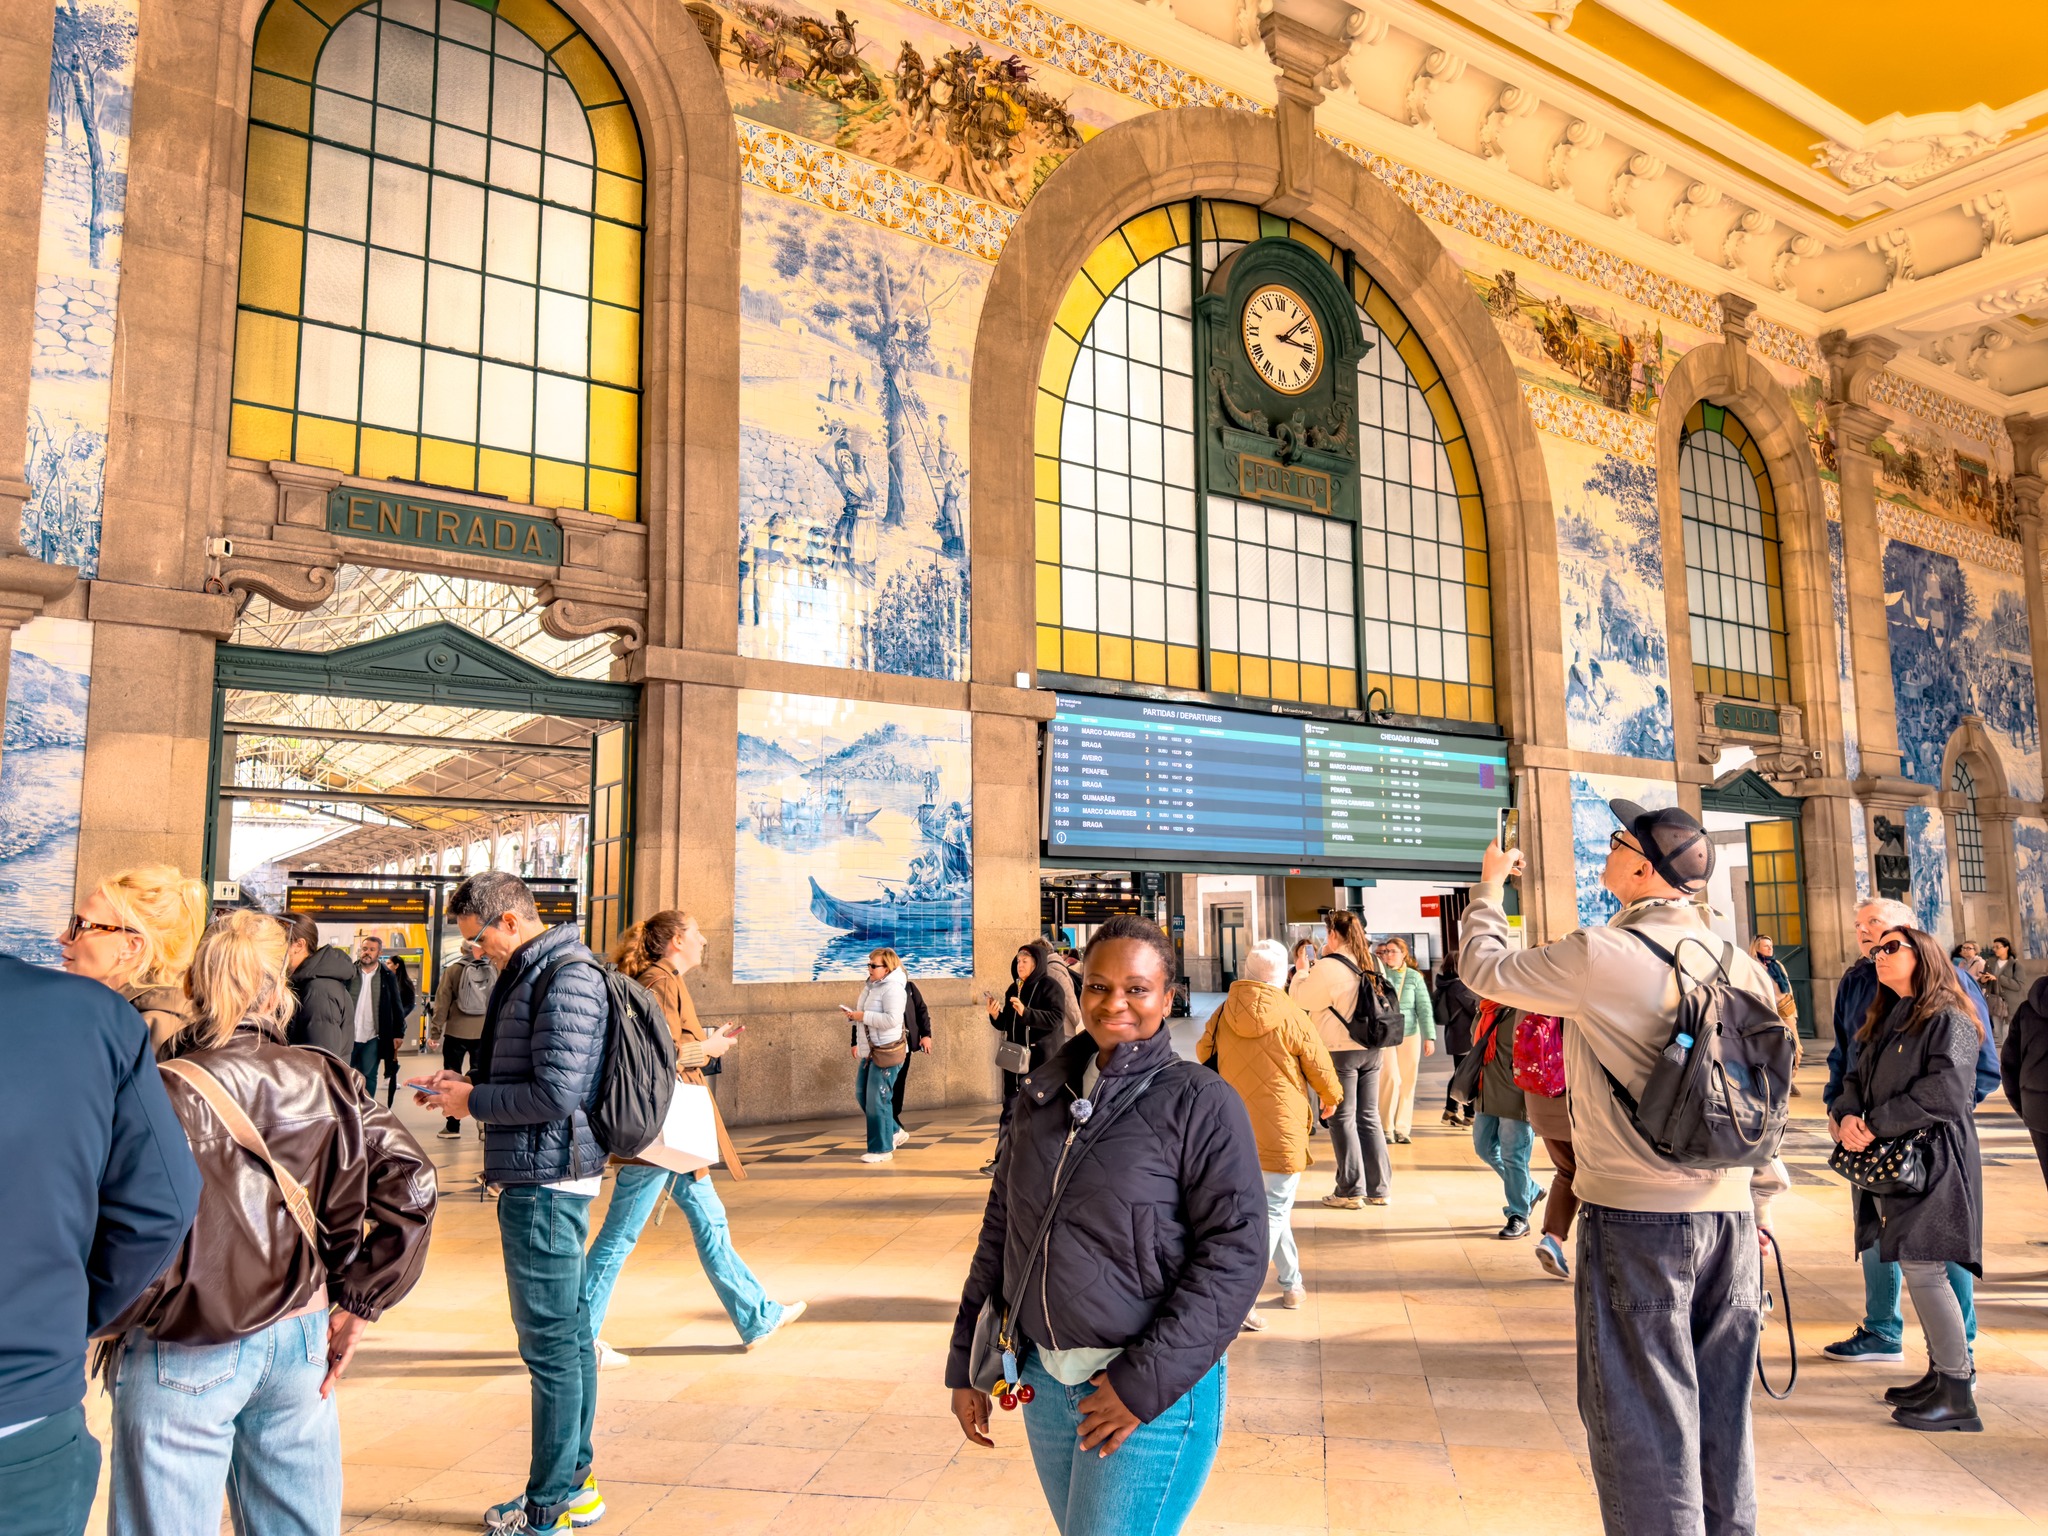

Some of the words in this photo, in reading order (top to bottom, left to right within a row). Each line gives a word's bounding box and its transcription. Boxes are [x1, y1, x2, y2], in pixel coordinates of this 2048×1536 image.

[1254, 463, 1316, 498] PORTO
[347, 496, 544, 558] ENTRADA
[1143, 708, 1175, 718] PARTIDAS
[1180, 712, 1222, 723] DEPARTURES
[1722, 708, 1770, 730] SAIDA
[1082, 728, 1102, 736] MARCO
[1103, 729, 1135, 738] CANAVESES
[1380, 733, 1410, 743] CHEGADAS
[1413, 736, 1439, 746] ARRIVALS
[1082, 794, 1115, 802] GUIMARÃES
